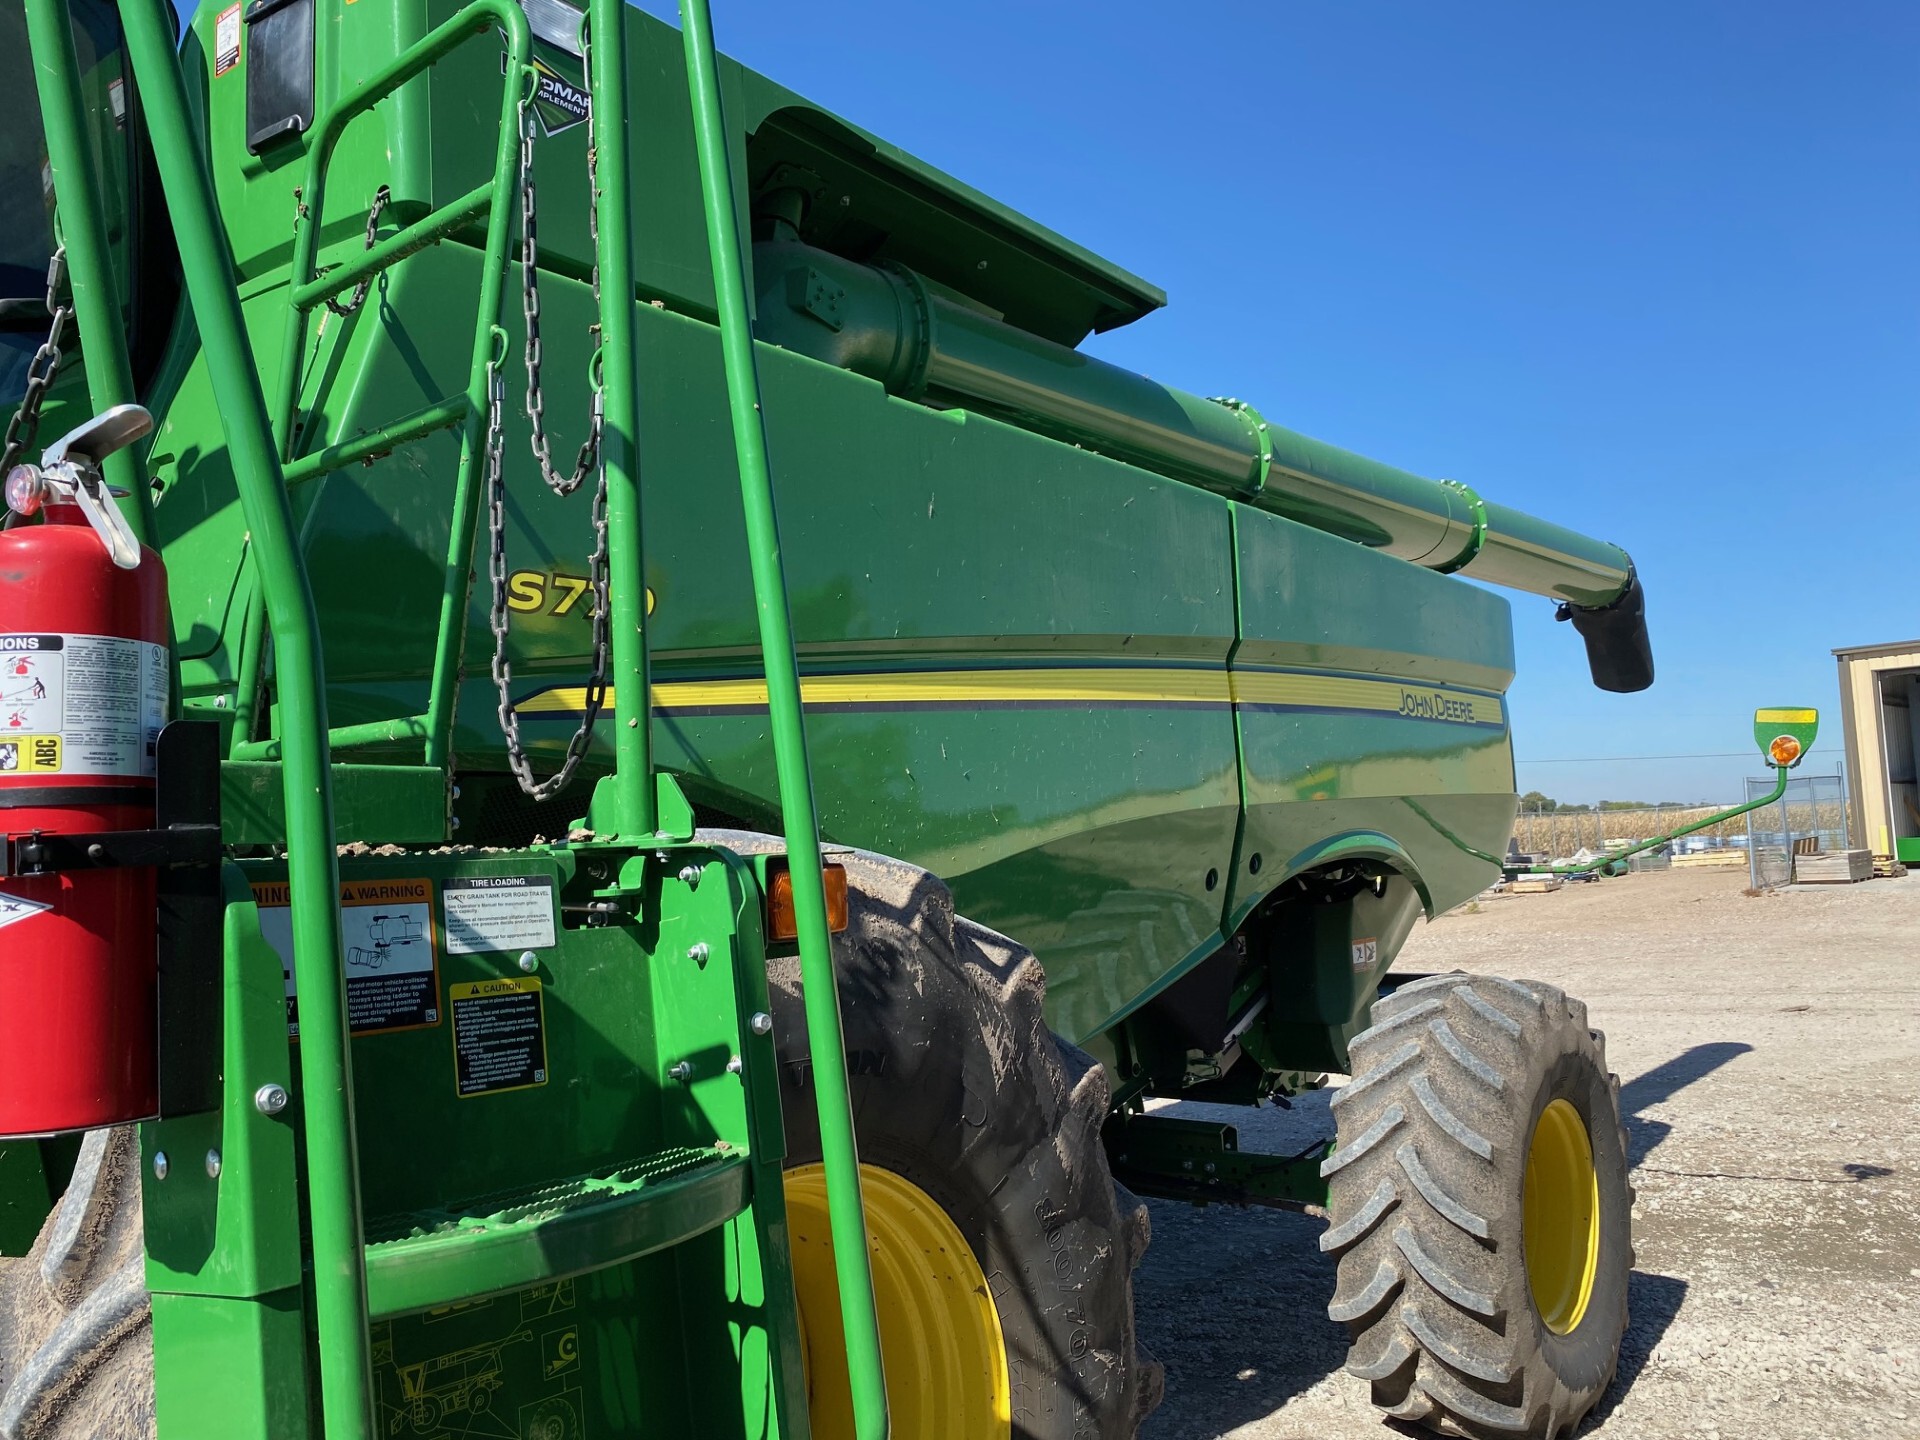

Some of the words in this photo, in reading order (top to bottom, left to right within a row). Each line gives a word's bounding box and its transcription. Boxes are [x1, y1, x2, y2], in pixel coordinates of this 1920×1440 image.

[538, 90, 586, 116] MPLEMENT
[0, 637, 39, 650] IONS
[1399, 689, 1434, 717] JOHN
[1434, 694, 1475, 721] DEERE
[35, 739, 57, 767] ABC
[490, 878, 525, 887] LOADING
[357, 885, 425, 899] WARNING
[484, 983, 521, 993] CAUTION
